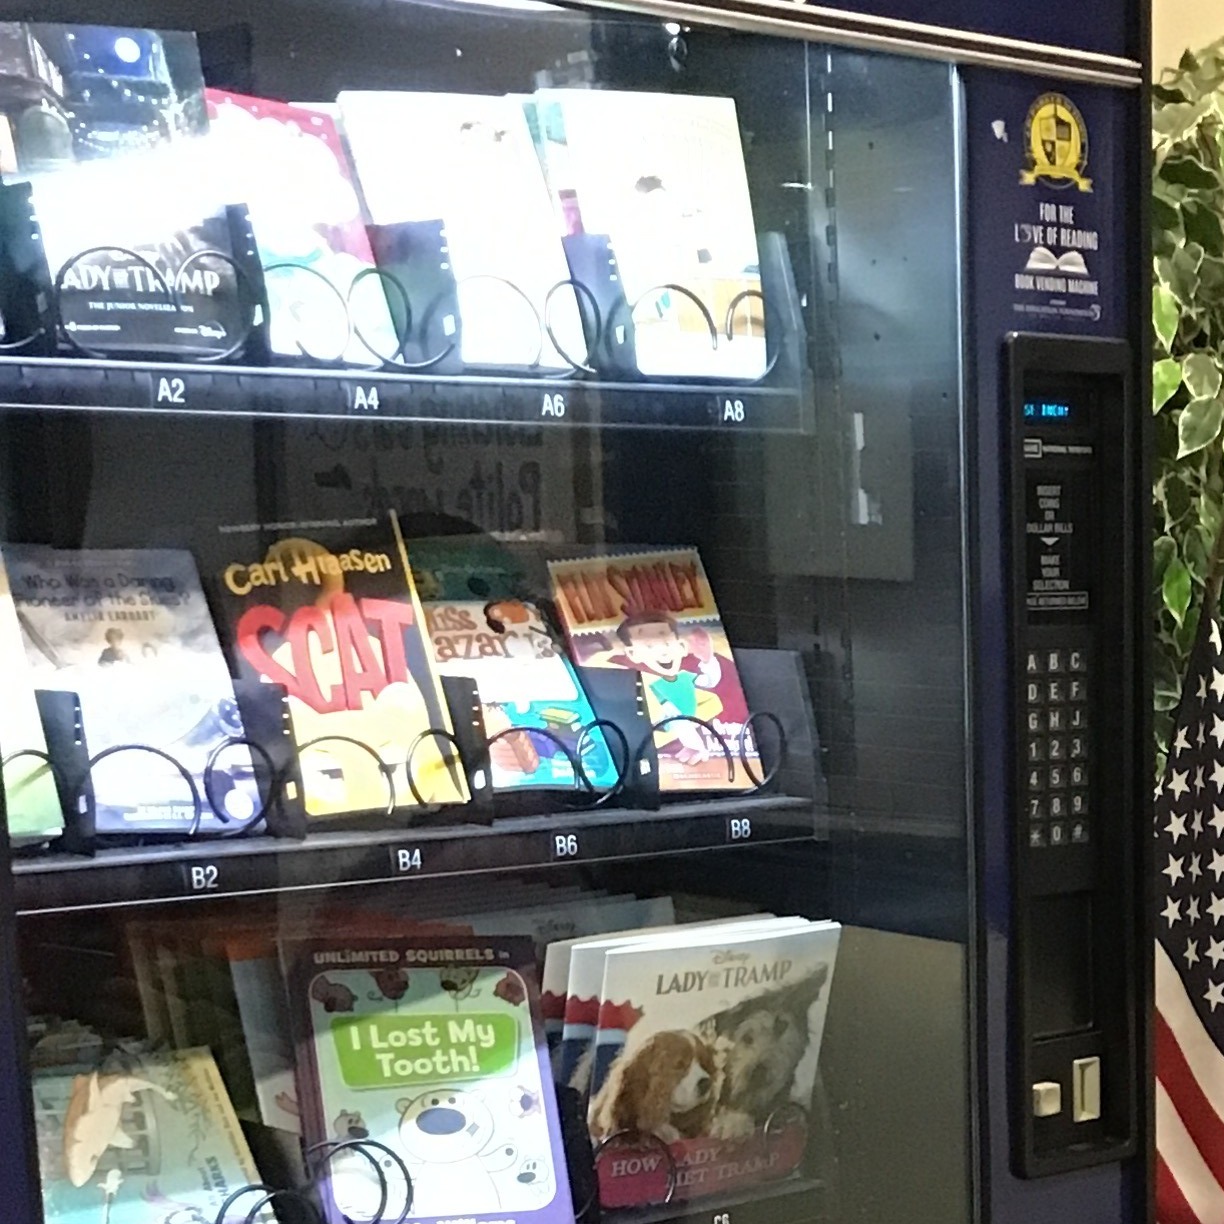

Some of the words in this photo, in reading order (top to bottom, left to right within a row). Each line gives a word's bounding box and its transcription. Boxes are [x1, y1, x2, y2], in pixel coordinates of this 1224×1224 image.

[1039, 202, 1057, 223] FOR
[1058, 204, 1075, 225] THE
[1046, 226, 1058, 246] OF
[1060, 227, 1099, 251] READING
[89, 301, 105, 311] THE
[157, 377, 186, 404] A2
[354, 386, 380, 411] A4
[541, 394, 566, 418] A6
[723, 399, 745, 422] A8
[20, 574, 61, 590] Who
[104, 577, 116, 589] a
[224, 552, 289, 595] Carl
[236, 592, 414, 715] SCAT
[1027, 654, 1036, 671] A
[1050, 653, 1058, 670] B
[1071, 652, 1080, 669] C
[1029, 684, 1037, 700] D
[1050, 682, 1059, 700] E
[1072, 681, 1079, 698] F
[1029, 713, 1038, 730] G
[1050, 711, 1059, 729] H
[1072, 710, 1080, 726] J
[1030, 742, 1036, 758] 1
[1051, 740, 1060, 757] 2
[1073, 739, 1081, 755] 3
[1030, 771, 1038, 786] 4
[1051, 769, 1060, 785] 5
[1073, 767, 1081, 782] 6
[1031, 800, 1038, 815] 7
[1052, 797, 1060, 813] 8
[1074, 796, 1082, 811] 9
[730, 818, 752, 840] B8
[1053, 826, 1061, 842] 0
[555, 834, 579, 857] B6
[398, 848, 423, 872] B4
[191, 866, 219, 890] B2
[404, 948, 495, 964] SQUIRRELS
[655, 968, 711, 996] LADY
[722, 959, 793, 989] TRAMP
[350, 1026, 362, 1051] I
[369, 1021, 441, 1049] Lost
[449, 1019, 496, 1048] My
[375, 1047, 481, 1078] Tooth!
[611, 1153, 663, 1178] HOW
[715, 1152, 781, 1181] TRAMP
